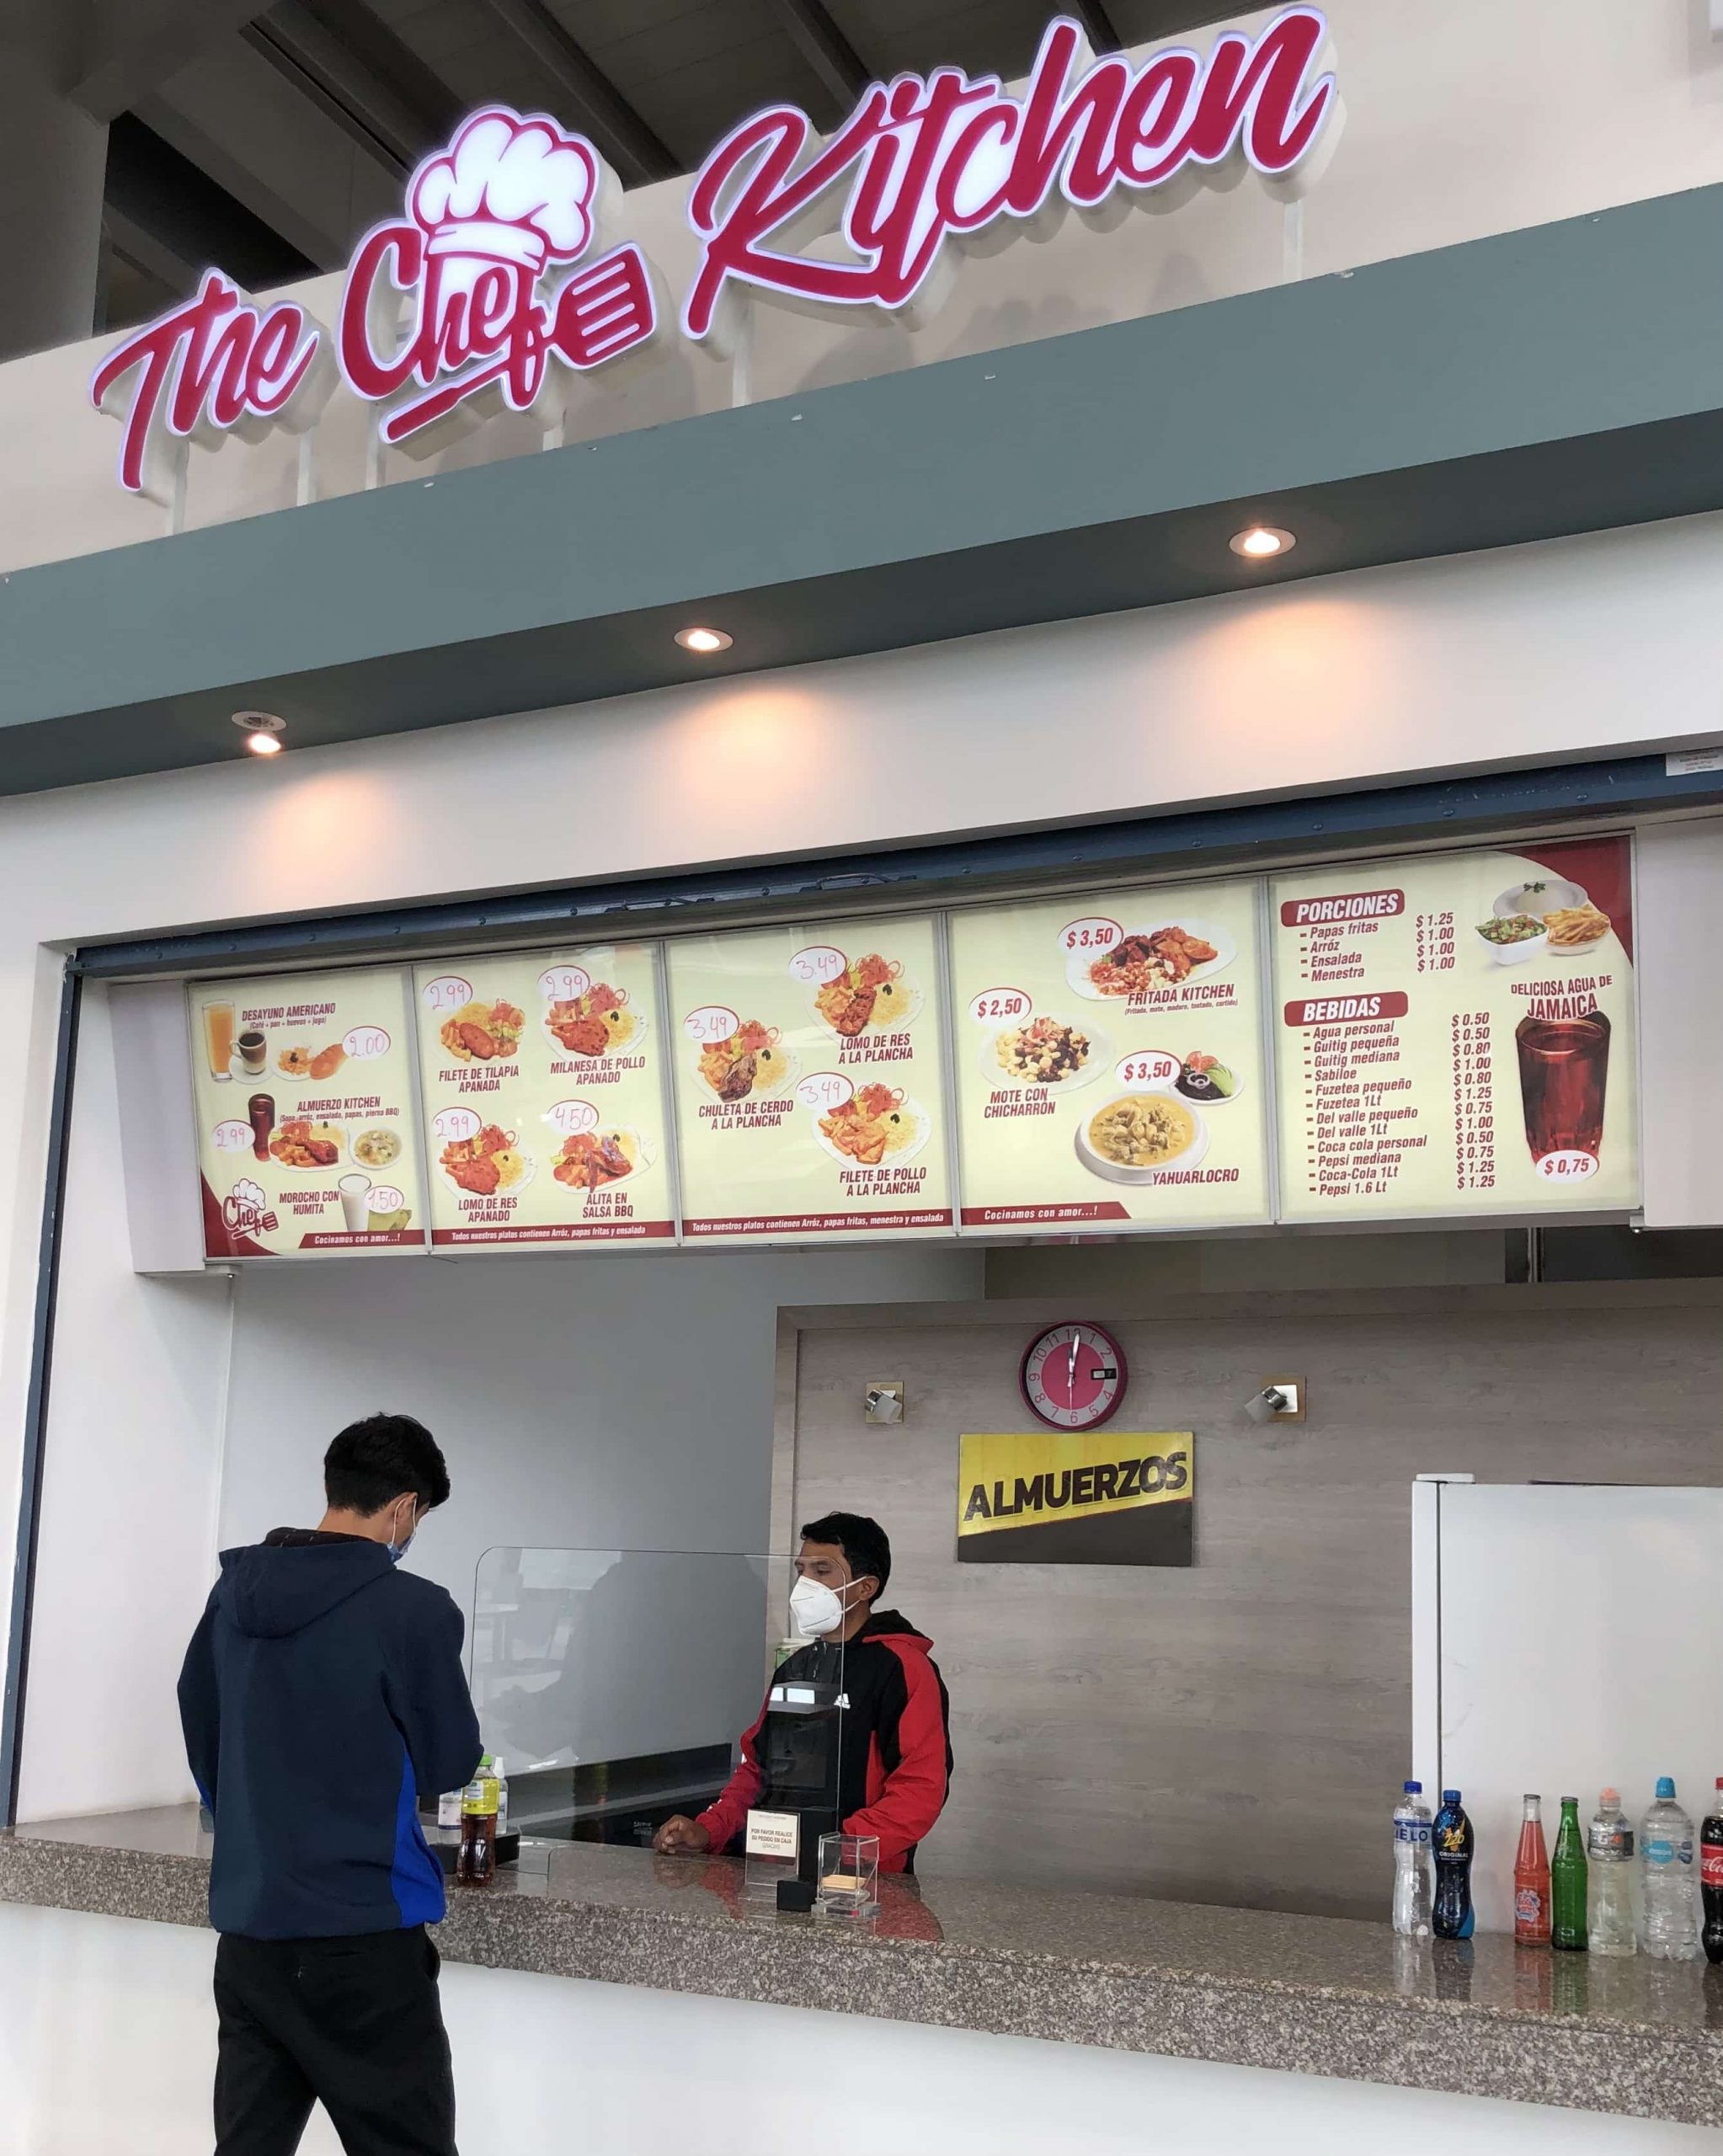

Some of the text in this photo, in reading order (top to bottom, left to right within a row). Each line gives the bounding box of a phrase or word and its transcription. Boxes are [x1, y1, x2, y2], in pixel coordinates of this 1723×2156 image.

[90, 12, 1335, 490] The Chef Kitchen
[1296, 893, 1399, 923] PORCIONES
[1427, 912, 1454, 926] 1.25
[1067, 927, 1113, 949] $ 3,50
[1310, 921, 1379, 941] Papas fritas
[1428, 927, 1454, 941] 1.00
[1310, 939, 1340, 953] Arróz
[1428, 942, 1454, 956] 1.00
[1310, 952, 1362, 968] Ensalada
[1429, 957, 1455, 969] 1.00
[1311, 967, 1365, 982] Menestra
[1511, 975, 1613, 995] DELICIOSA AGUA DE
[1128, 984, 1235, 1006] FRITADA KITCHEN
[242, 1002, 336, 1022] DESAYUNO AMERICANO
[978, 997, 1022, 1018] $ 2,50
[1303, 996, 1381, 1022] BEBIDAS
[1527, 993, 1598, 1020] JAMAICA
[1462, 1012, 1490, 1026] 0.50
[1313, 1020, 1395, 1040] Agua personal
[840, 1033, 910, 1050] LOMO DE RES
[1314, 1036, 1400, 1054] Guitig pequeña
[838, 1047, 914, 1065] A LA PLANCHA
[1315, 1051, 1400, 1068] Guitig mediana
[439, 1065, 520, 1081] FILETE DE TILAPIA
[550, 1056, 646, 1075] MILANESA DE POLLO
[1124, 1061, 1171, 1081] $ 3,50
[576, 1071, 621, 1086] APANADO
[1315, 1068, 1357, 1082] Sabiloe
[459, 1080, 500, 1093] APANADA
[1315, 1078, 1412, 1097] Fuzetea pequeño
[1465, 1086, 1492, 1099] 1.25
[990, 1087, 1048, 1103] MOTE CON
[296, 1096, 381, 1112] ALMUERZO KITCHEN
[699, 1100, 793, 1118] CHULETA DE CERDO
[984, 1102, 1056, 1118] CHICHARRON
[1316, 1097, 1360, 1110] Fuzetea
[1465, 1102, 1492, 1114] 0.75
[711, 1114, 781, 1130] A LA PLANCHA
[1316, 1107, 1418, 1124] Del valle pequeño
[1467, 1116, 1493, 1129] 1.00
[1317, 1127, 1336, 1139] Del
[1339, 1123, 1366, 1137] valle
[1317, 1134, 1427, 1153] Coca cola personal
[1467, 1145, 1494, 1159] 0.75
[1318, 1152, 1401, 1169] Pepsi mediana
[1469, 1160, 1495, 1173] 1.25
[1544, 1158, 1589, 1176] $ 0,75
[839, 1166, 926, 1183] FILETE DE POLLO
[1152, 1168, 1240, 1186] YAHUARLOCRO
[1319, 1167, 1377, 1182] Coca-Cola
[279, 1190, 339, 1203] MOROCHO CON
[846, 1181, 920, 1197] A LA PLANCHA
[1319, 1181, 1387, 1198] Pepsi 1.6 Lt
[458, 1197, 518, 1211] LOMO DE RES
[586, 1192, 627, 1206] ALITA EN
[223, 1196, 260, 1236] Chef
[293, 1203, 324, 1214] HUMITA
[468, 1209, 510, 1223] APANADO
[582, 1204, 633, 1219] SALSA BBQ
[984, 1205, 1097, 1220] Cocinamos con amor...!
[692, 1222, 712, 1231] Todos
[712, 1222, 742, 1230] nuestros
[743, 1220, 765, 1230] platos
[766, 1220, 800, 1229] contienen
[824, 1219, 845, 1228] papas
[870, 1215, 903, 1225] menestra
[904, 1216, 910, 1225] y
[910, 1214, 943, 1223] ensalada
[315, 1235, 354, 1244] Cocinamos
[963, 1451, 1188, 1523] ALMUERZOS
